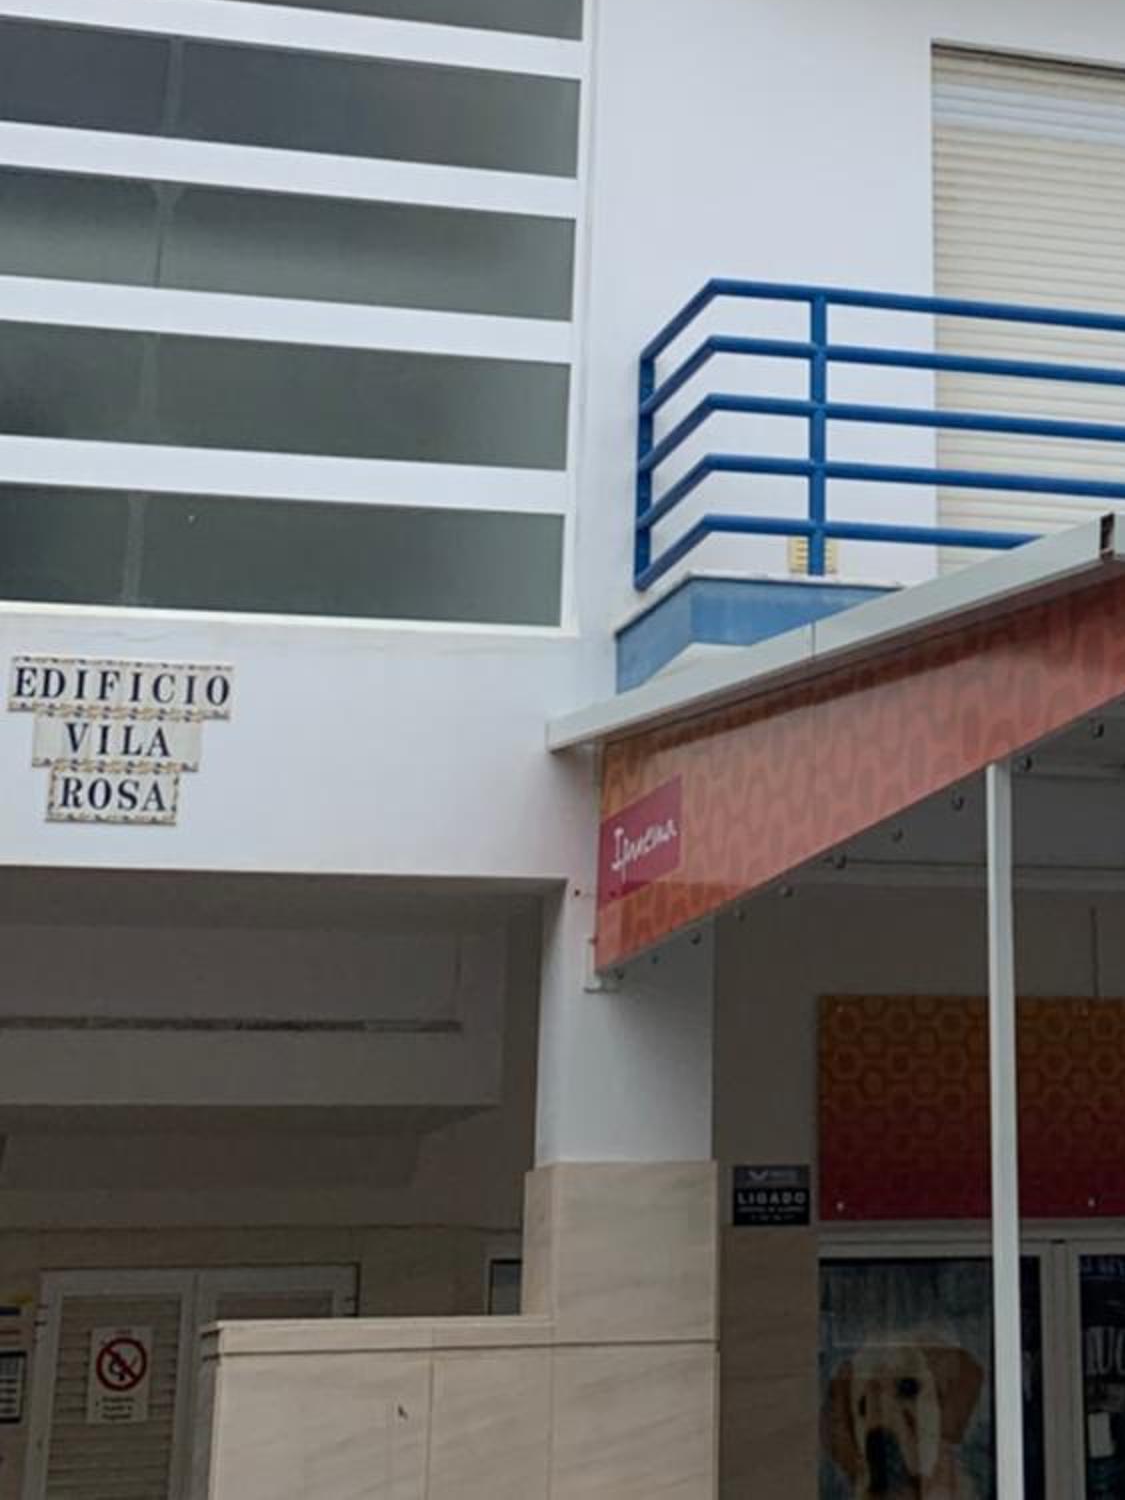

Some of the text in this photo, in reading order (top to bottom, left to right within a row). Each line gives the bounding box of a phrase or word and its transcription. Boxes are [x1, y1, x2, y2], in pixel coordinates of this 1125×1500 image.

[14, 666, 230, 706] EDIFICIO
[65, 722, 171, 757] VILA
[60, 777, 167, 812] ROSA
